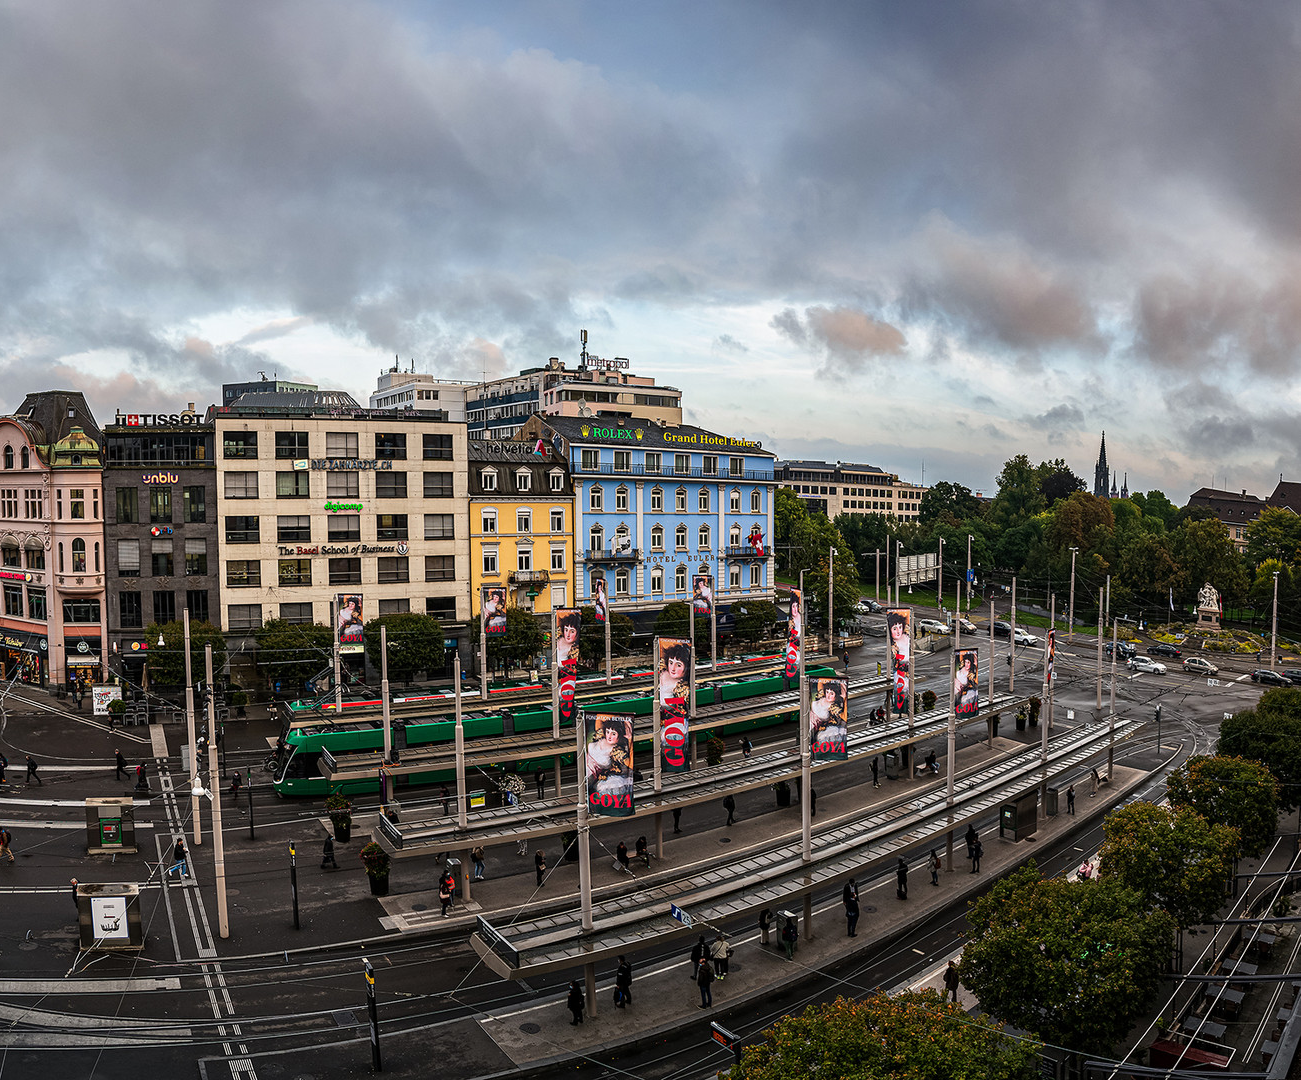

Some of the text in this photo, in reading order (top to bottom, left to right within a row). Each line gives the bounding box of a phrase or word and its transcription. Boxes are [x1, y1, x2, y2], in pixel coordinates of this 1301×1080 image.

[587, 358, 629, 370] metropol
[140, 414, 204, 426] TISSOT
[593, 428, 633, 440] ROLEX
[663, 432, 756, 448] Grand Hotel Euler
[486, 442, 532, 454] helvetia
[142, 471, 179, 484] unblu
[324, 501, 364, 513] digicomp
[278, 544, 395, 556] The Basel School of Business
[646, 554, 715, 563] HOTEL EULER
[486, 625, 506, 634] GOYA
[340, 634, 362, 643] GOYA
[560, 658, 577, 717] GOYA
[663, 696, 685, 767] GOYA
[812, 741, 846, 753] GOYA
[589, 792, 632, 808] GOYA
